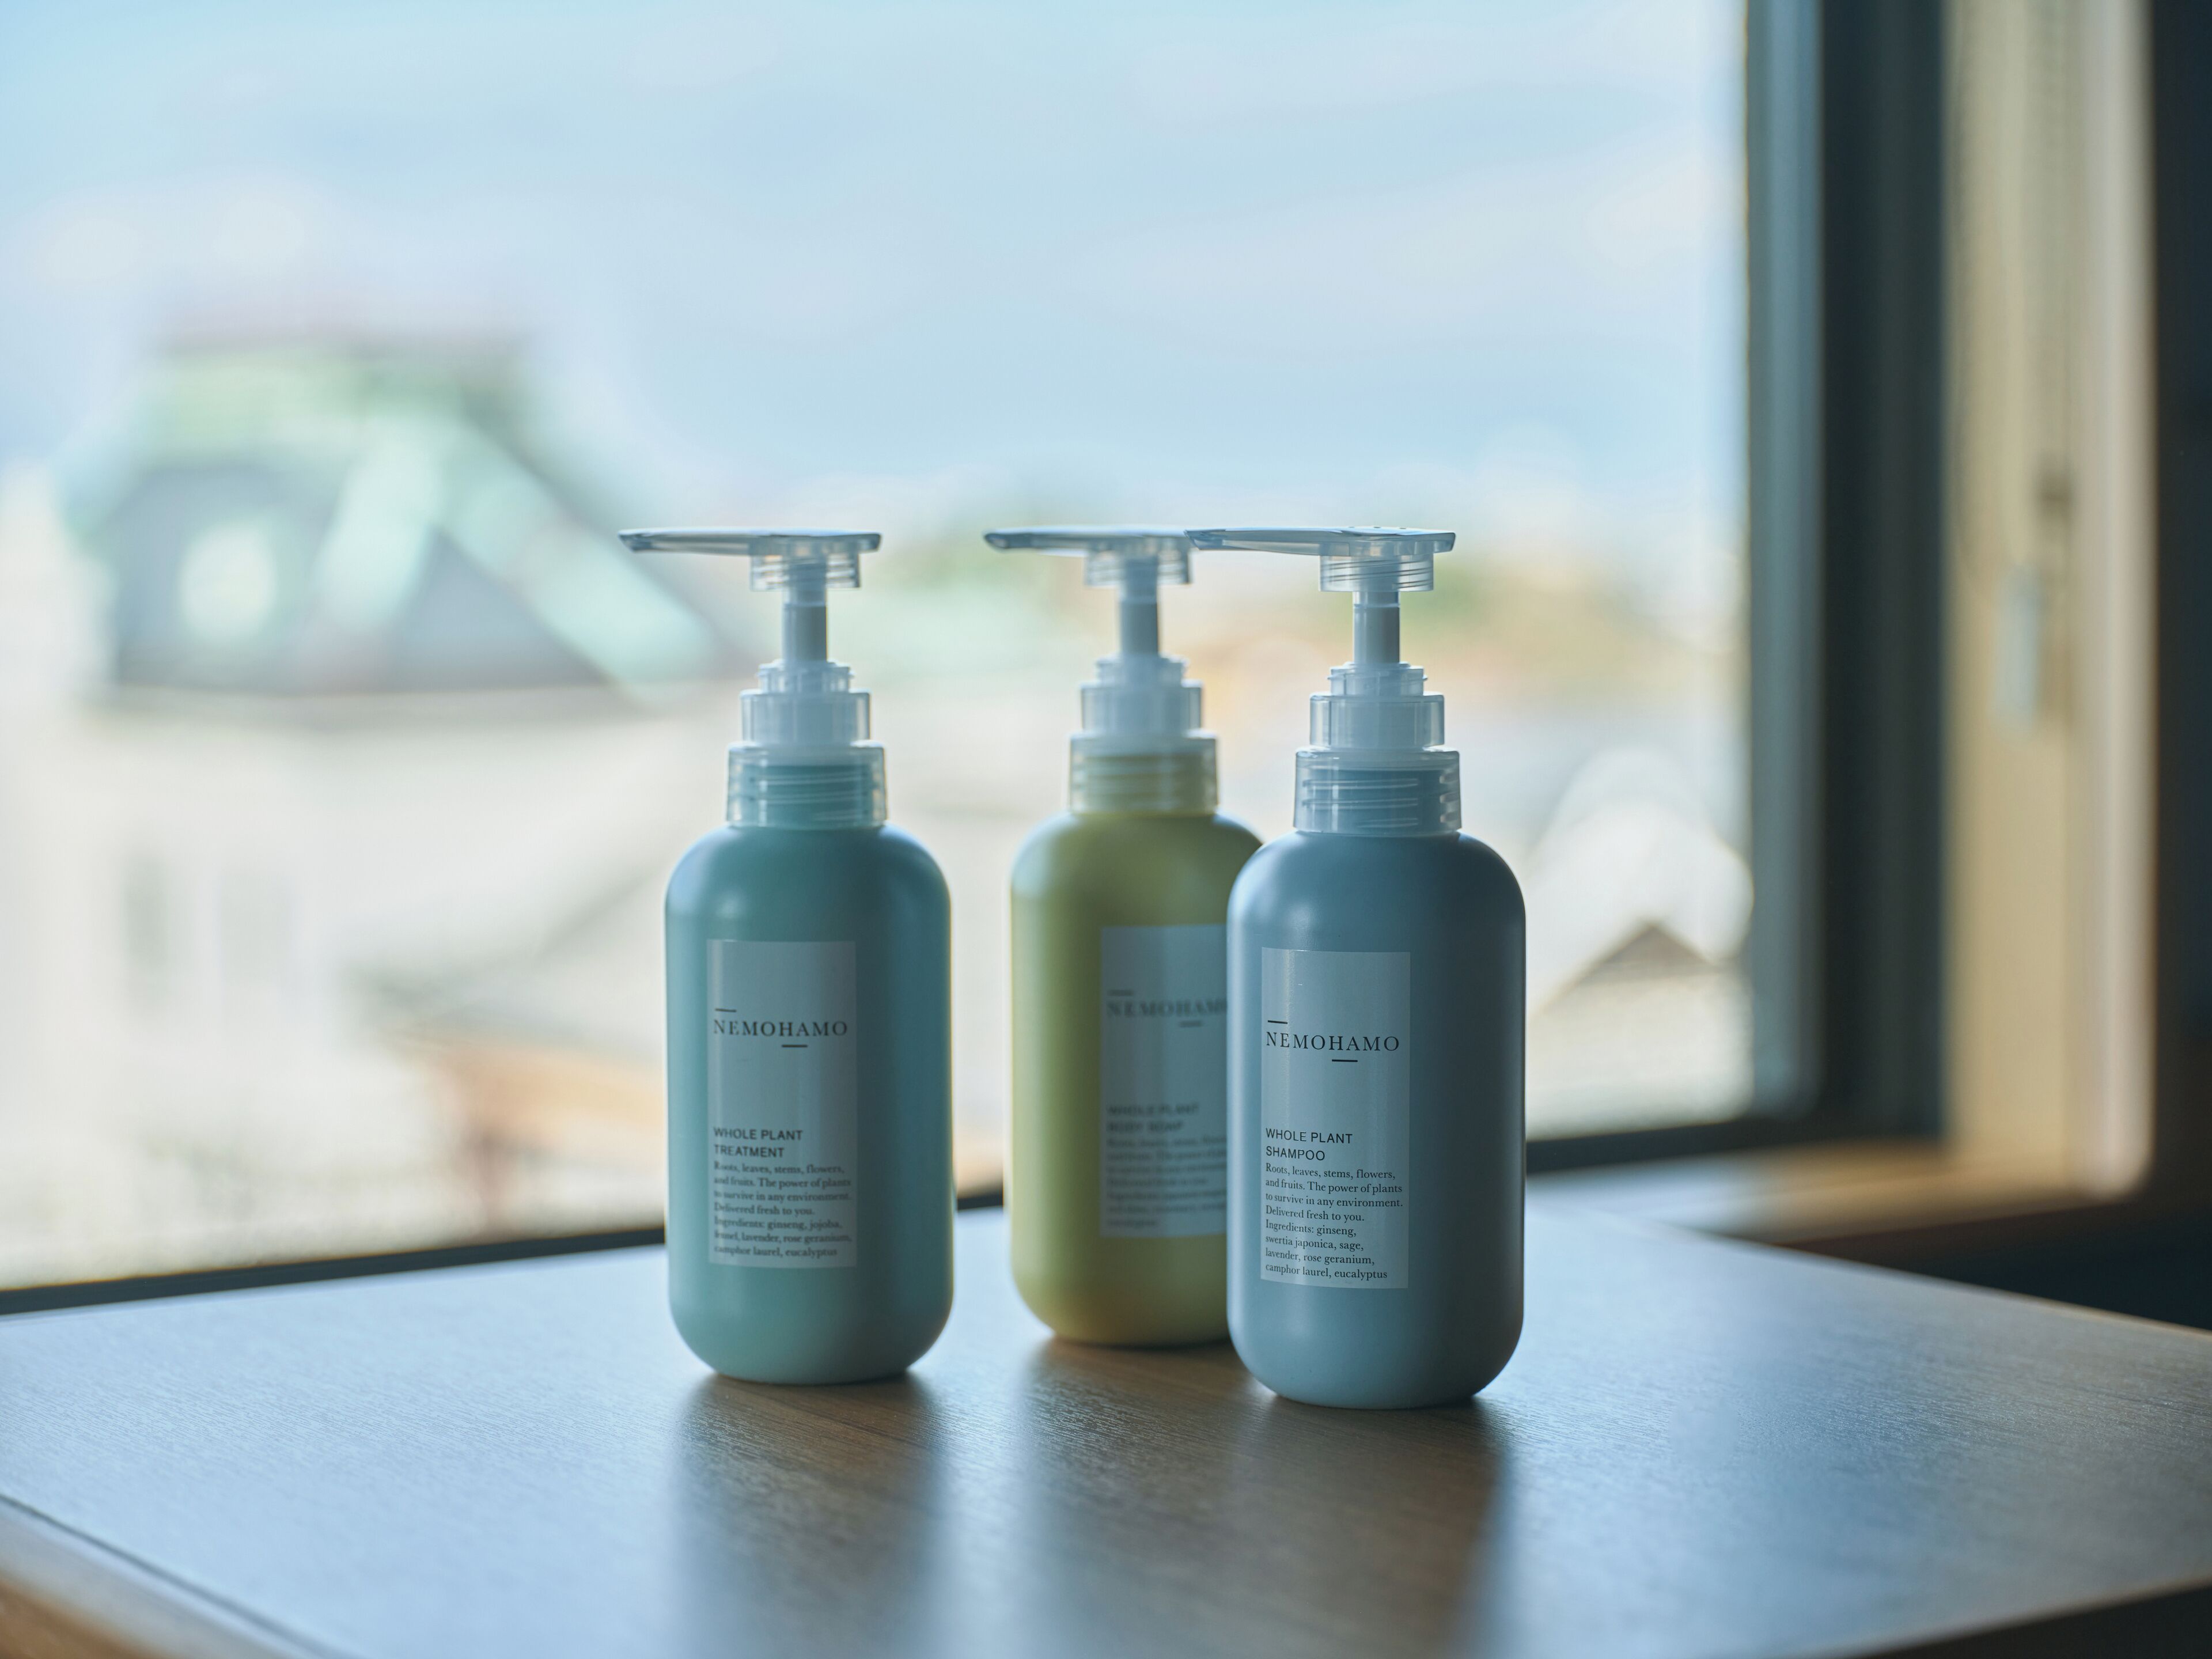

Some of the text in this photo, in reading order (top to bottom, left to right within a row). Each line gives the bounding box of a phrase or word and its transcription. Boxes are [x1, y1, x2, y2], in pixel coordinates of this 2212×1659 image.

[1107, 998, 1226, 1018] NEMOHAM
[714, 1020, 847, 1037] NEMOHAMO
[1266, 1032, 1399, 1051] NEMOHAMO
[714, 1127, 803, 1140] WHOLE PLANT
[1266, 1128, 1353, 1143] WHOLE PLANT
[714, 1145, 784, 1157] TREATMENT
[1266, 1146, 1325, 1160] SHAMPOO
[742, 1164, 772, 1174] leaves,
[774, 1166, 804, 1174] stems,
[806, 1164, 844, 1174] flowers,
[1266, 1163, 1395, 1180] Roots, leaves, stems, flowers,
[757, 1177, 776, 1187] The
[779, 1181, 809, 1190] power
[810, 1178, 821, 1187] of
[823, 1178, 851, 1189] plants
[1266, 1179, 1402, 1195] and fruits. The power of plants
[724, 1191, 754, 1200] survive
[757, 1191, 766, 1200] in
[768, 1194, 785, 1204] any
[787, 1193, 852, 1202] environment.
[1274, 1195, 1303, 1203] survive
[1306, 1196, 1315, 1205] in
[1317, 1199, 1334, 1208] any
[1336, 1198, 1403, 1207] environment.
[714, 1202, 755, 1214] Delivered
[757, 1205, 779, 1215] fresh
[795, 1209, 815, 1218] you.
[1266, 1205, 1304, 1218] Delivered
[1306, 1210, 1328, 1219] fresh
[1344, 1215, 1364, 1223] you.
[767, 1219, 808, 1230] ginseng,
[809, 1219, 843, 1232] jojoba,
[1266, 1219, 1357, 1237] Ingredients: ginseng,
[741, 1232, 781, 1243] lavender,
[804, 1233, 853, 1245] geranium,
[1266, 1235, 1363, 1252] swertia japonica, sage,
[714, 1246, 837, 1259] camphor laurel, eucalyptus
[1266, 1248, 1301, 1262] lavender,
[1324, 1255, 1374, 1266] geranium,
[1266, 1263, 1387, 1280] camphor laurel, eucalyptus
